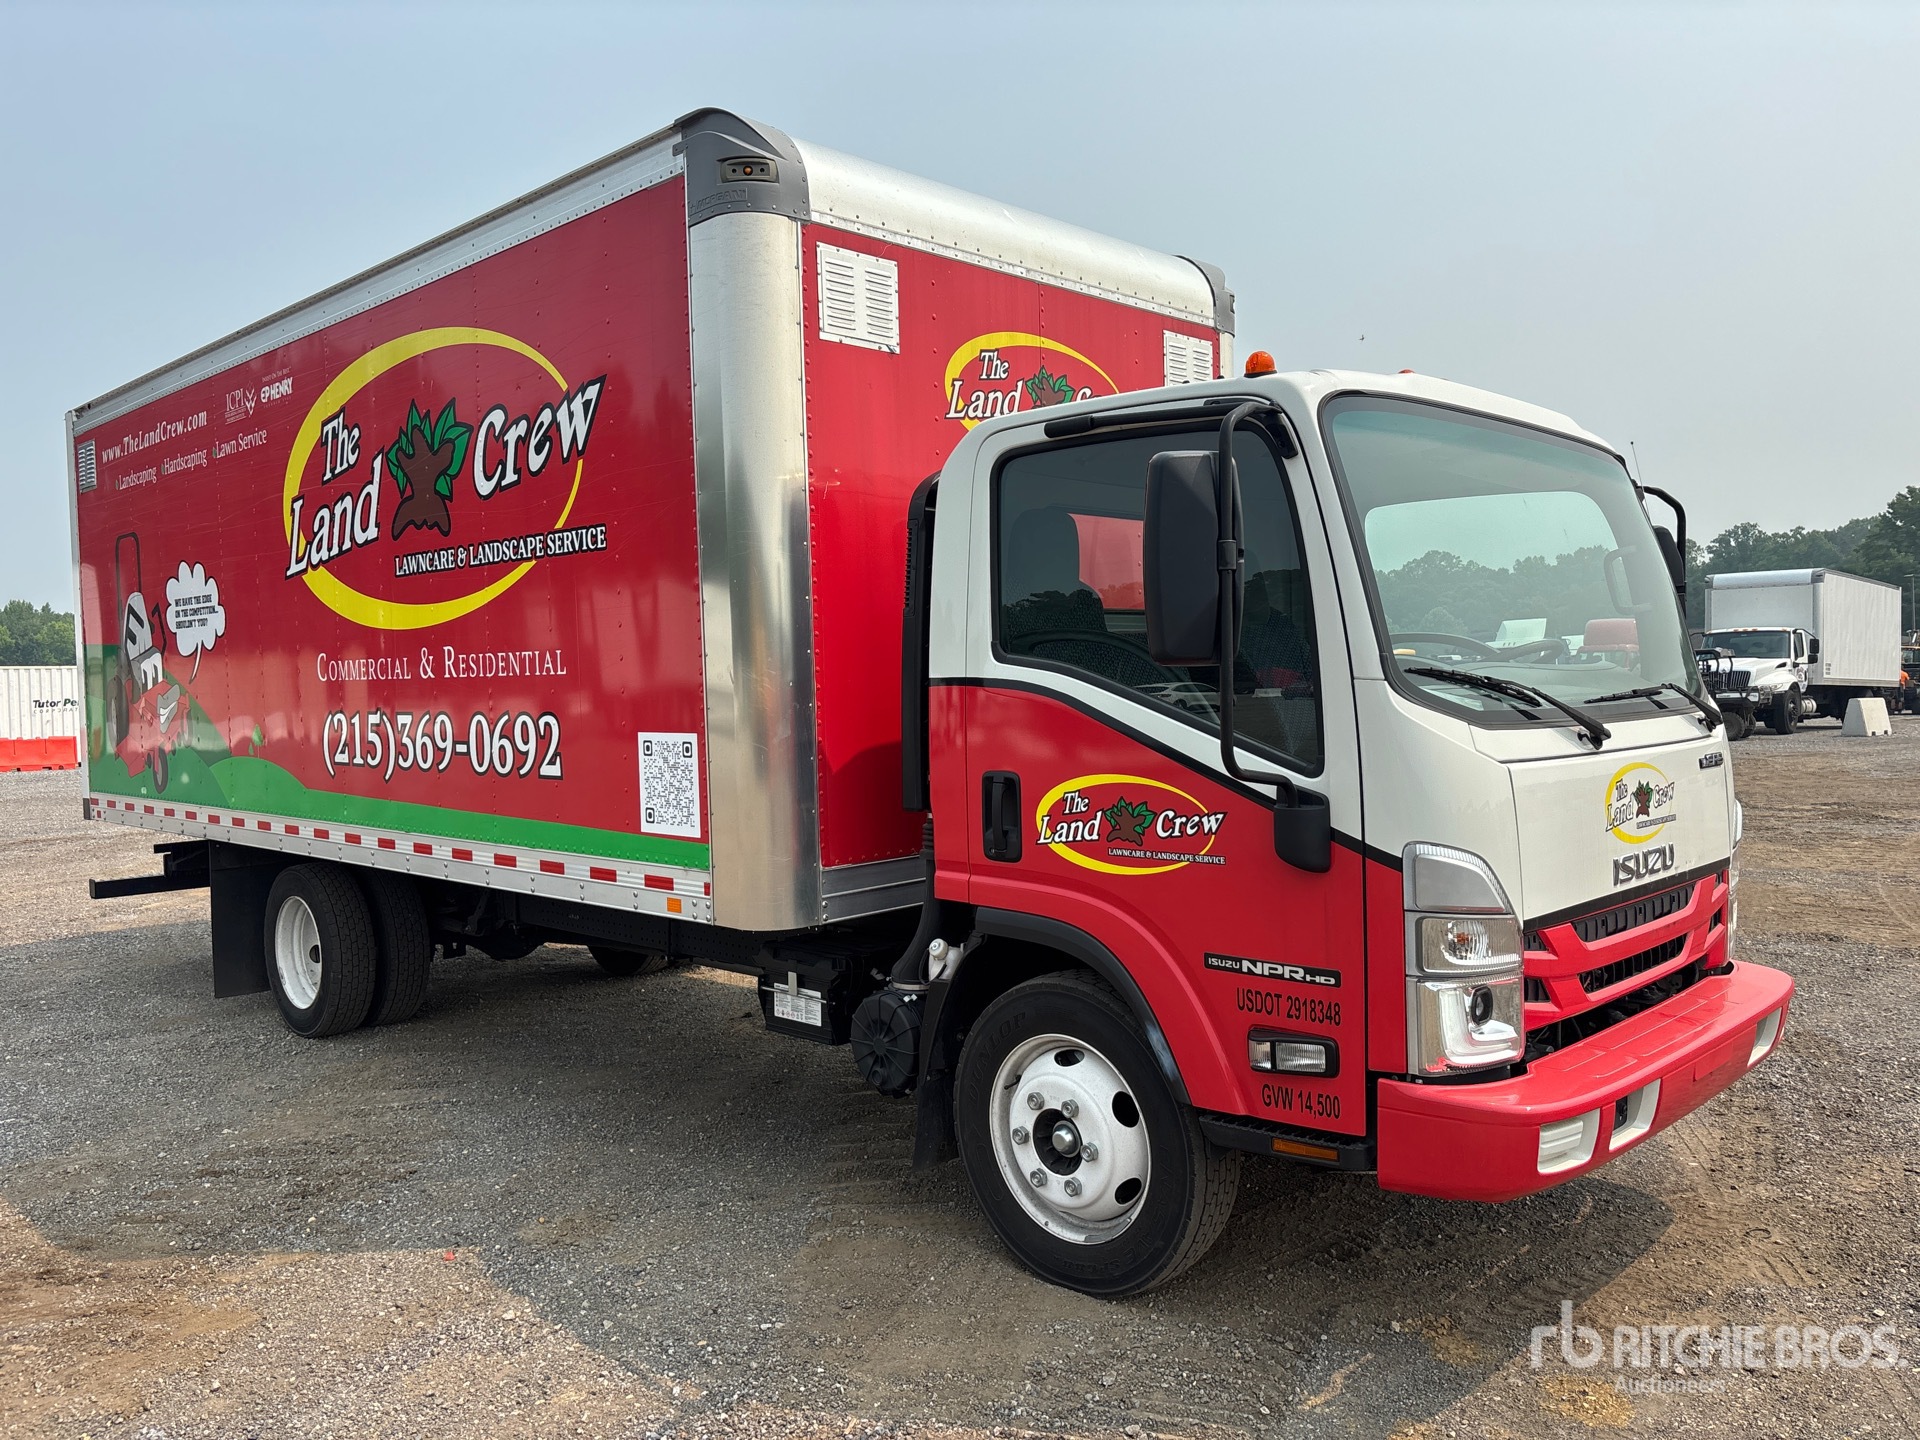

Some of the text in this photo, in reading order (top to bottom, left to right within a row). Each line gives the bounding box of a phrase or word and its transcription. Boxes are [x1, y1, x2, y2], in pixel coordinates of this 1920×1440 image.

[980, 350, 1009, 380] The
[226, 388, 244, 412] ICPI
[270, 377, 293, 400] HENRY
[946, 379, 1024, 418] Land
[101, 409, 208, 464] www.TheLandCrew.com
[215, 428, 268, 459] Lawn Service
[322, 410, 360, 483] The
[118, 466, 157, 491] Landscaping
[163, 448, 208, 476] Hardscaping
[286, 381, 602, 577] Land Crew
[395, 526, 607, 577] LAWNCARE & LANDSCAPE SERVICE
[316, 645, 567, 682] COMMERCIAL & RESIDENTIAL
[33, 698, 79, 708] Tutor Pe
[322, 710, 564, 783] (215)369-0692
[1063, 791, 1089, 814] The
[1606, 792, 1636, 832] Land
[1652, 782, 1675, 809] Crew
[1615, 778, 1628, 802] The
[1037, 810, 1225, 844] Land Crew
[1108, 848, 1226, 865] LAWNCARE & LANDSCAPE SERVICE
[1612, 842, 1675, 887] ISUZU
[1208, 957, 1336, 985] ISUZU NPR HD
[1236, 987, 1341, 1026] USDOT 2918348
[1261, 1083, 1341, 1120] GVW 14,500
